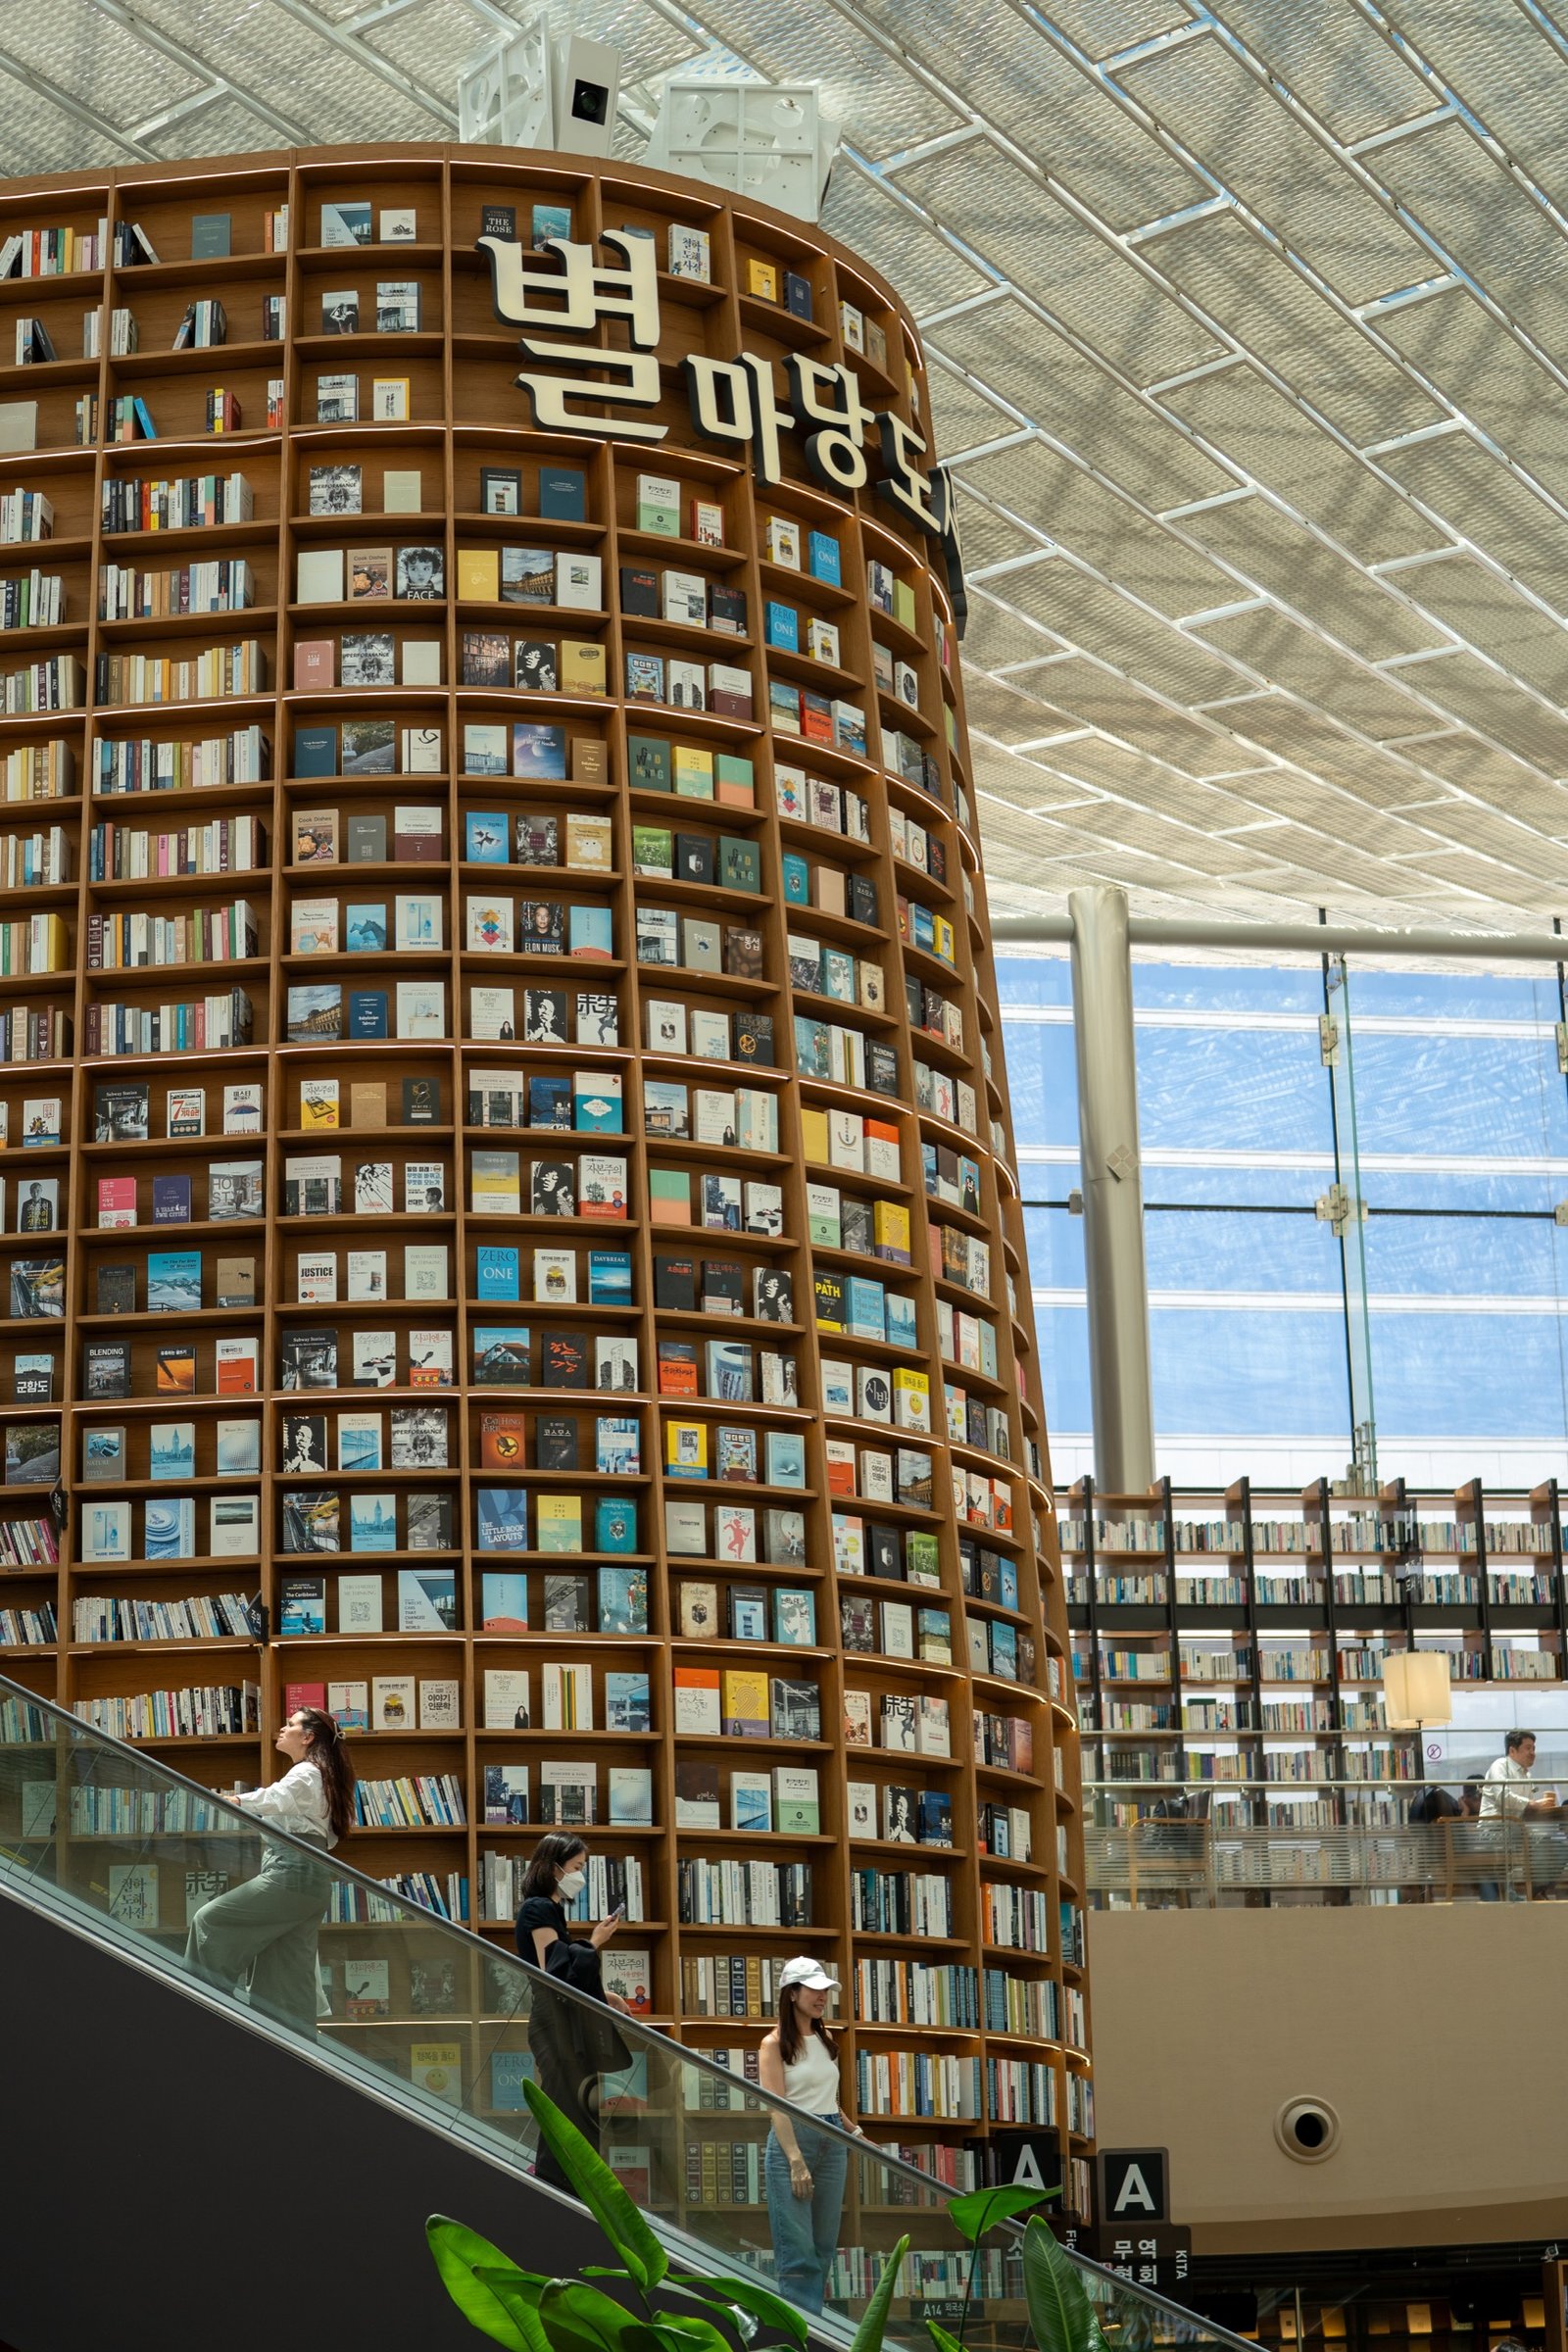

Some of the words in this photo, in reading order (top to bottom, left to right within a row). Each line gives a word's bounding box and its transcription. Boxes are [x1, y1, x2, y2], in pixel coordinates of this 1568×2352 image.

[485, 224, 513, 234] ROSE
[488, 218, 510, 226] THE
[816, 531, 838, 552] ZERO
[817, 551, 837, 567] ONE
[407, 590, 435, 601] FACE
[771, 606, 796, 623] ZERO
[774, 621, 795, 638] ONE
[524, 943, 542, 954] ELON
[543, 943, 562, 954] MUSK
[743, 935, 760, 952] 통섭
[304, 1083, 336, 1096] 자본주의
[586, 1162, 623, 1176] 자본주의
[212, 1176, 262, 1191] HOUSE
[212, 1190, 260, 1204] STYLE
[480, 1249, 517, 1262] ZERO
[300, 1267, 333, 1278] JUSTICE
[482, 1266, 514, 1280] ONE
[815, 1282, 841, 1298] PATH
[89, 1348, 124, 1356] BLENDING
[16, 1380, 48, 1395] 군함도
[544, 1428, 571, 1437] 코스모스
[481, 1526, 506, 1536] LITTLE
[506, 1524, 524, 1533] BOOK
[488, 1532, 523, 1544] LAYOUTS
[428, 1702, 451, 1711] 인문학
[607, 1957, 645, 1971] 자본주의
[494, 2054, 533, 2069] ZERO
[1012, 2143, 1046, 2191] A
[1114, 2163, 1155, 2212] A
[1005, 2236, 1023, 2261] 소
[1113, 2239, 1156, 2260] 무역
[1176, 2250, 1188, 2279] KITA
[923, 2303, 942, 2317] A14
